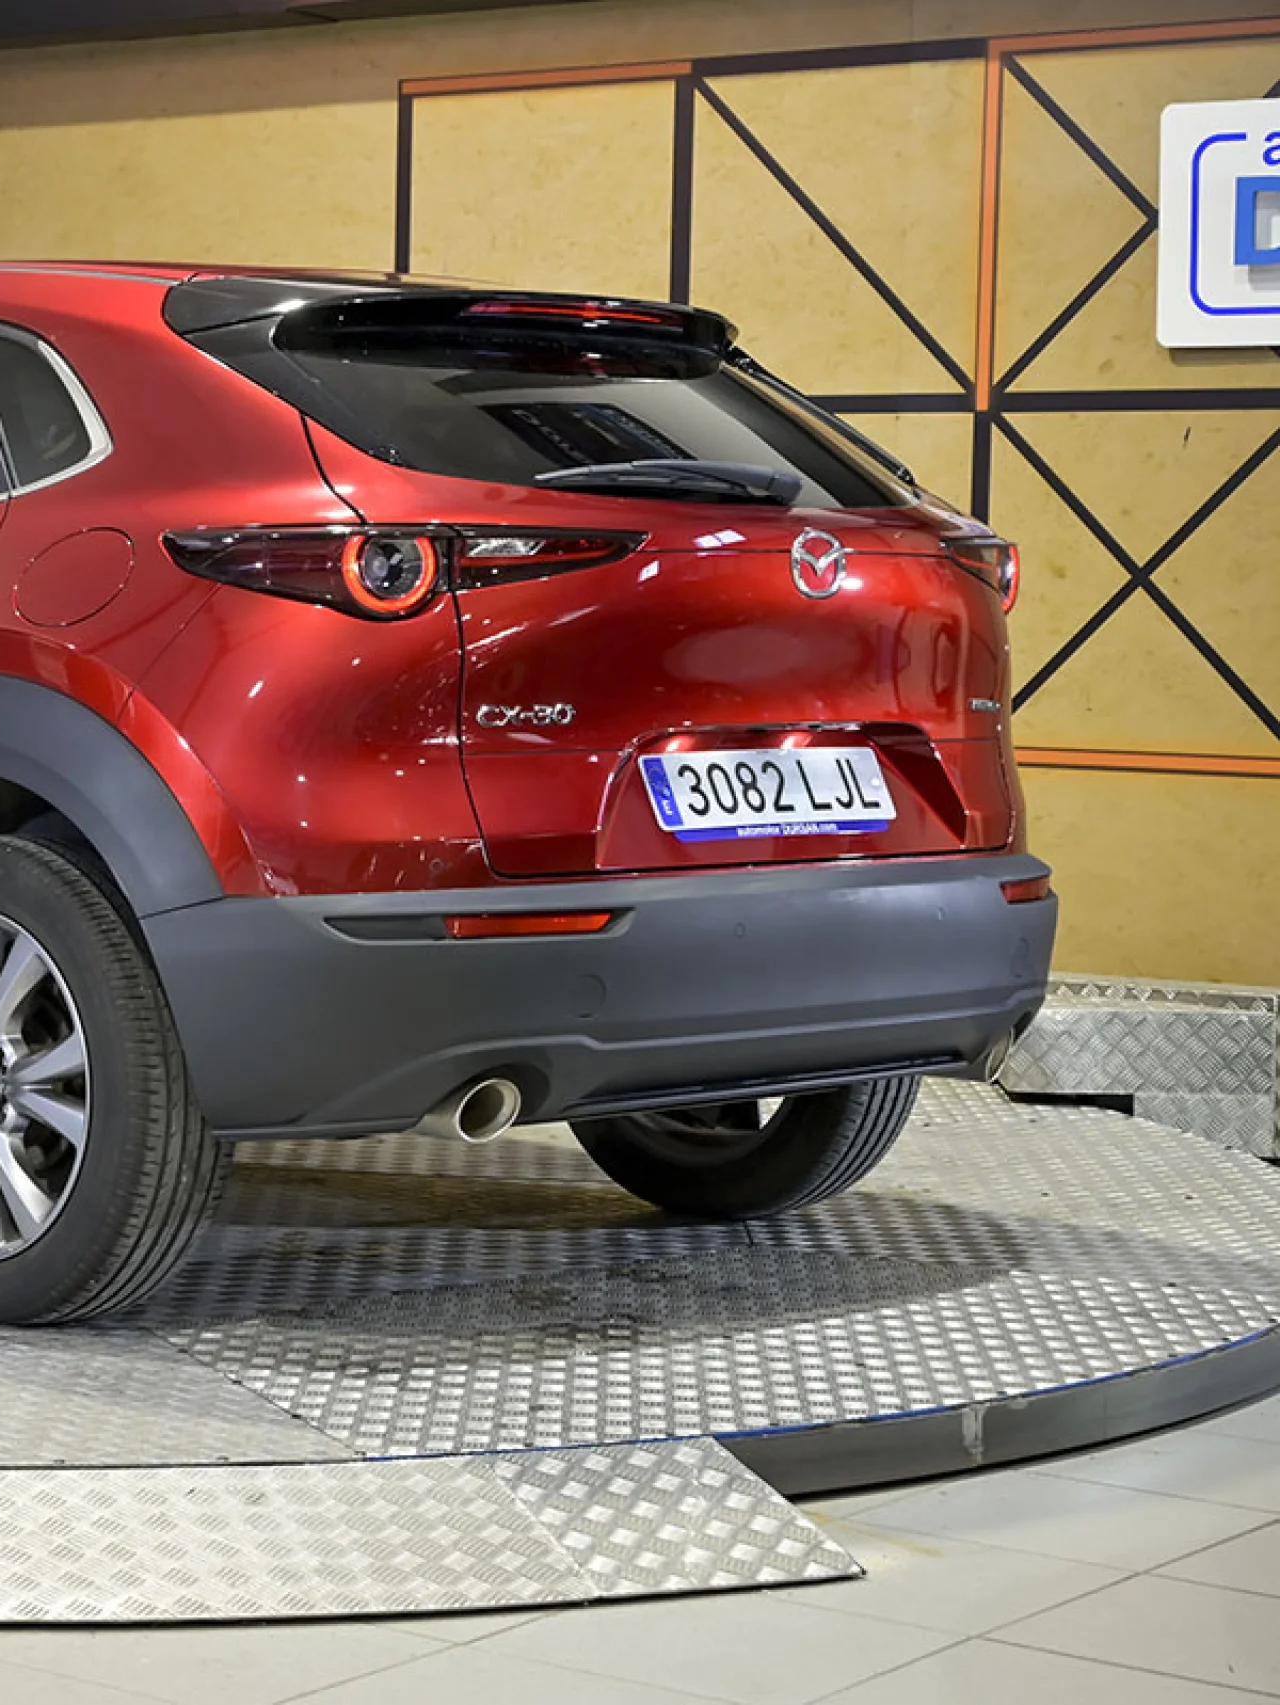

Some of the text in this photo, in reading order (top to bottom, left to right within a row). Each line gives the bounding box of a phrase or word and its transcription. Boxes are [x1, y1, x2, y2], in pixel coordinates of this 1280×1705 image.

[476, 702, 577, 727] CX-30
[677, 758, 881, 816] 3082 LJL
